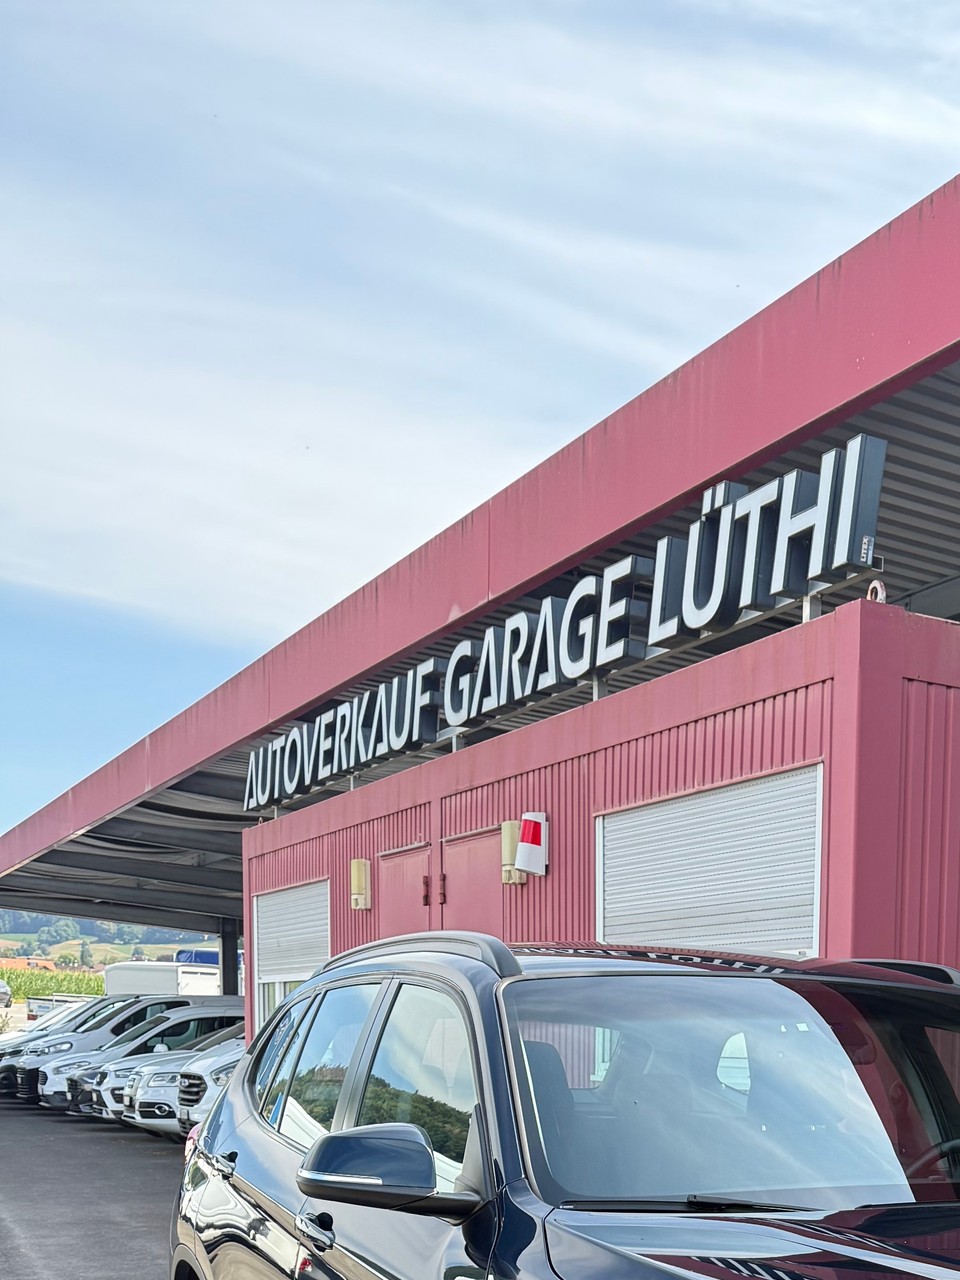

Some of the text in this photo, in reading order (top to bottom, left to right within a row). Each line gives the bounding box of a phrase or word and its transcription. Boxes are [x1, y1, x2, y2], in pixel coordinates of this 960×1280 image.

[243, 433, 864, 811] AUTOVERKAUF GARAGE LÜTHI
